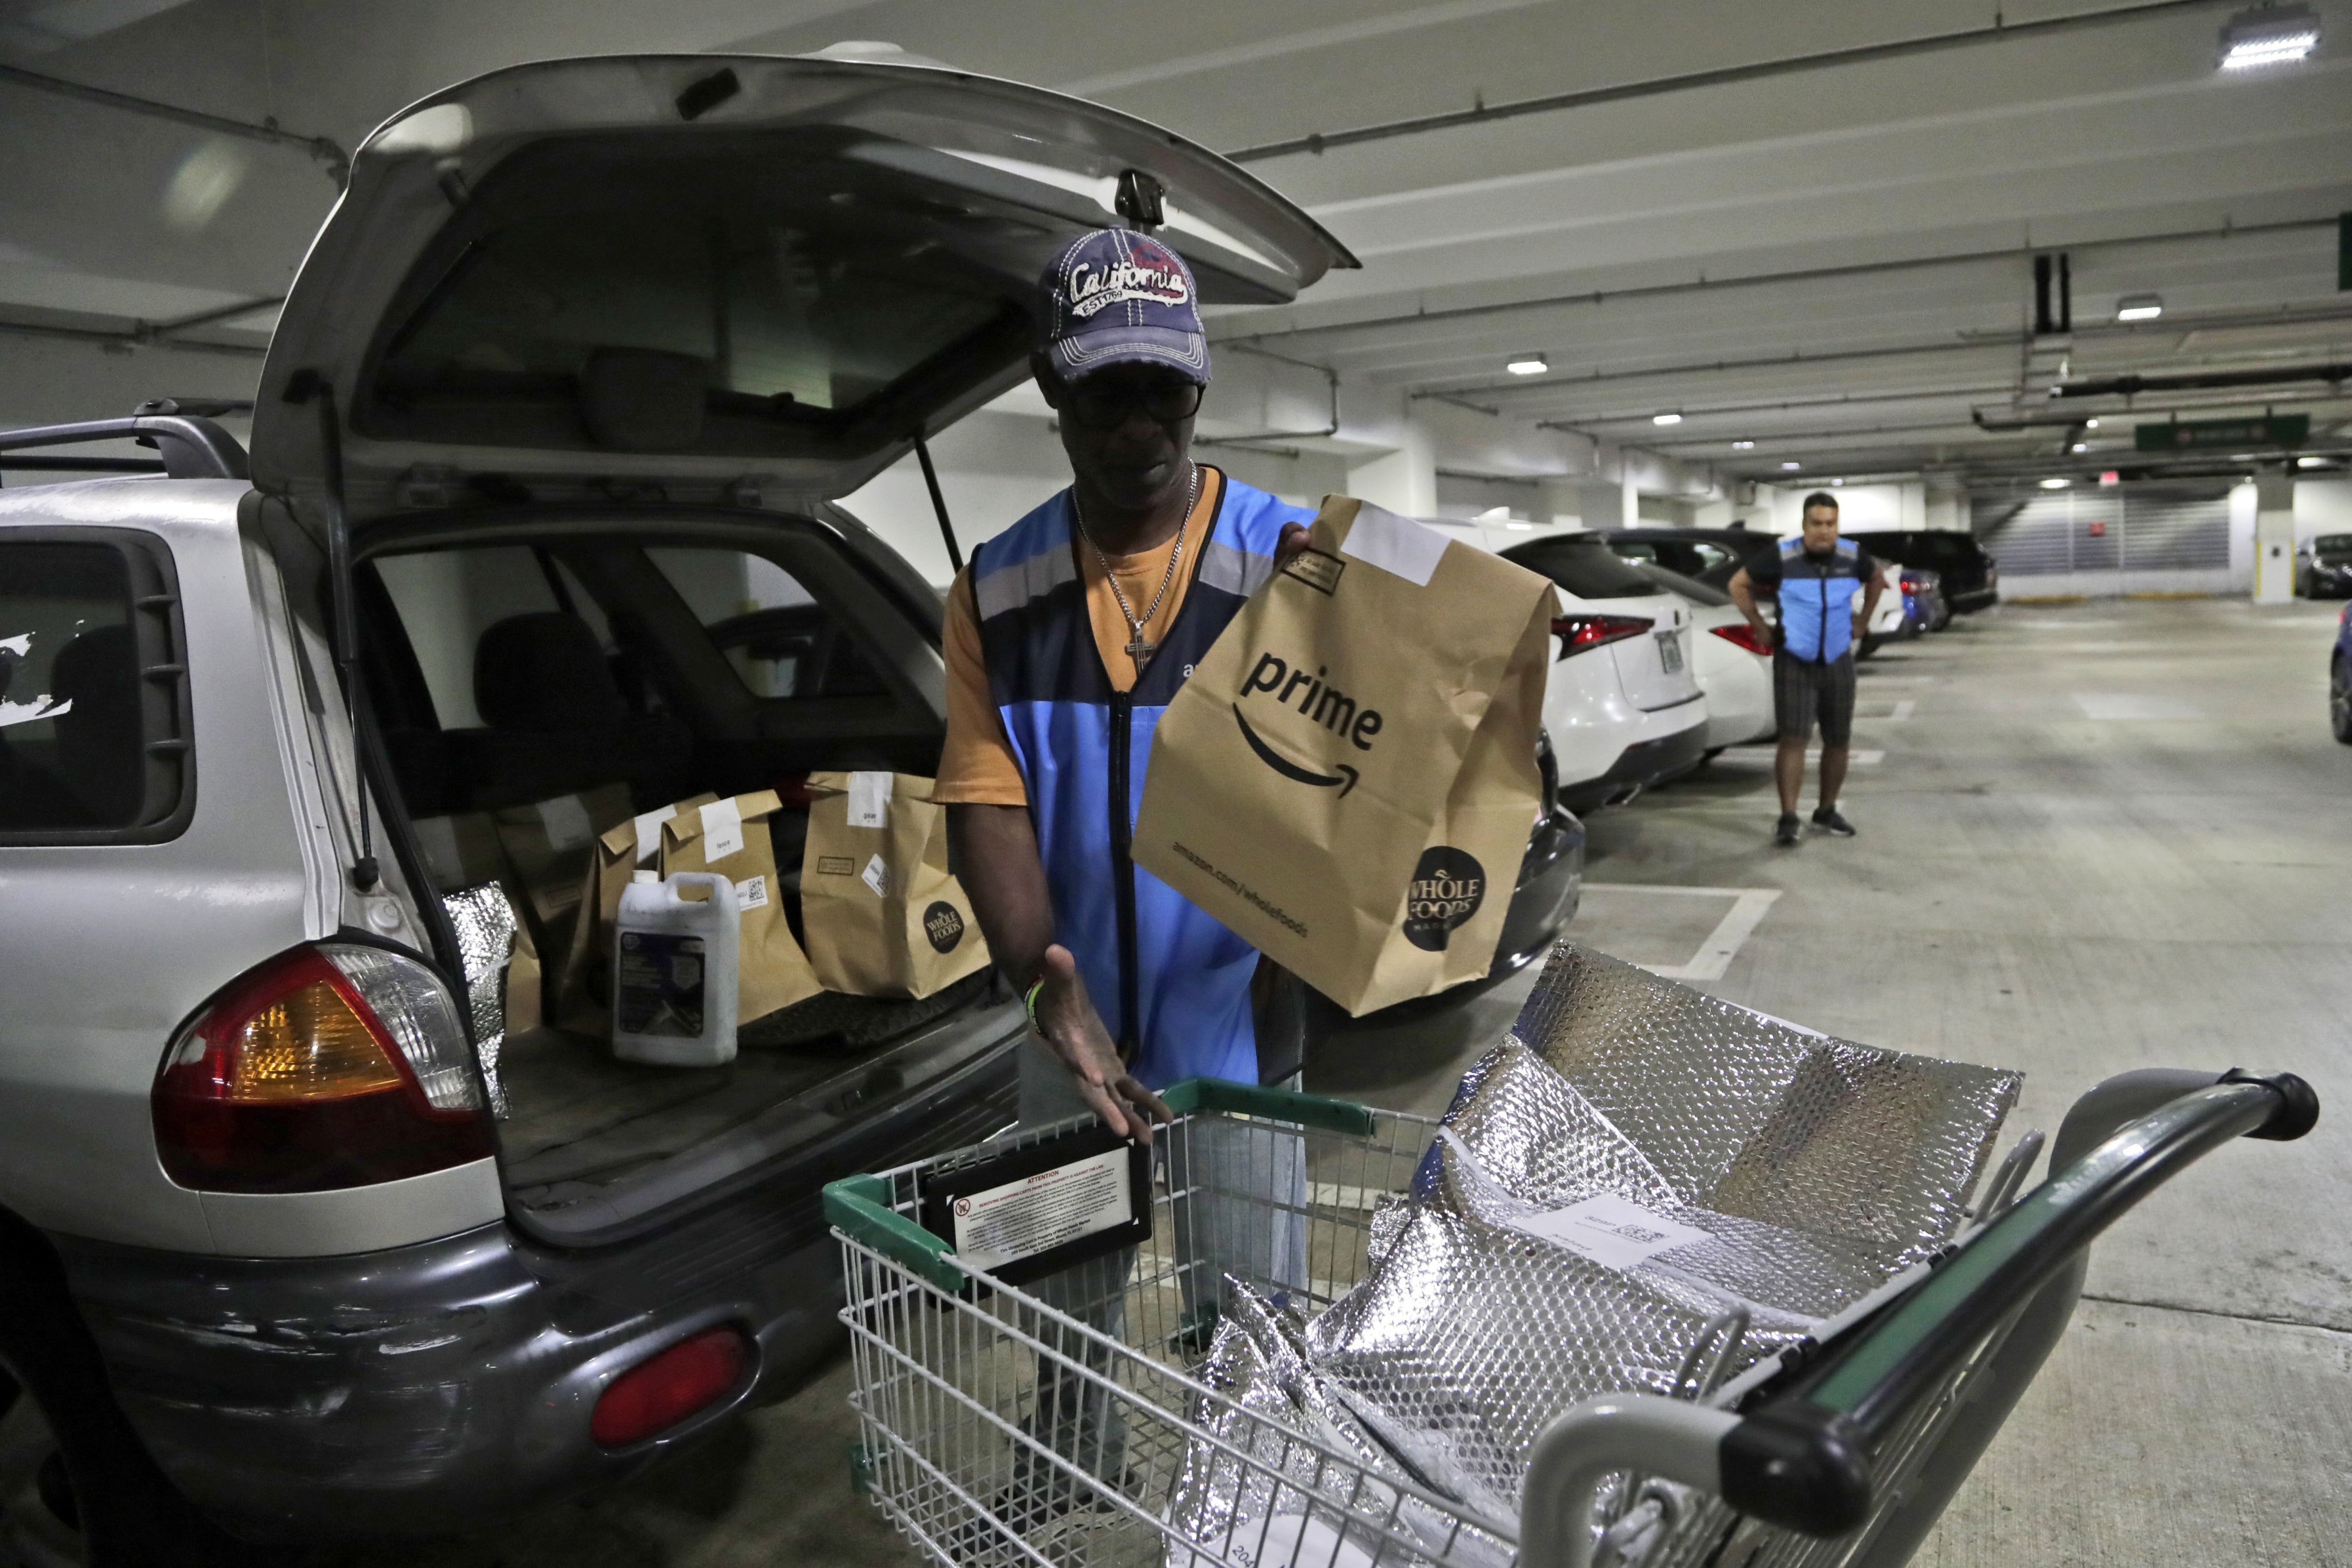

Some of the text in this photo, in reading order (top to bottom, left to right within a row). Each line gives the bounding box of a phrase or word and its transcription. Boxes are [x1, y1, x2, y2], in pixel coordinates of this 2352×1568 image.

[1070, 262, 1185, 303] California
[1239, 652, 1383, 752] prime
[1172, 841, 1309, 939] amazon.com/wholefoods
[926, 911, 957, 931] WHOLE
[933, 921, 961, 941] FOODS
[979, 1199, 999, 1207] REMOVING
[1000, 1192, 1019, 1201] SHOPPING
[1051, 1176, 1069, 1185] PROPERTY
[1027, 1170, 1059, 1185] ATTENTION
